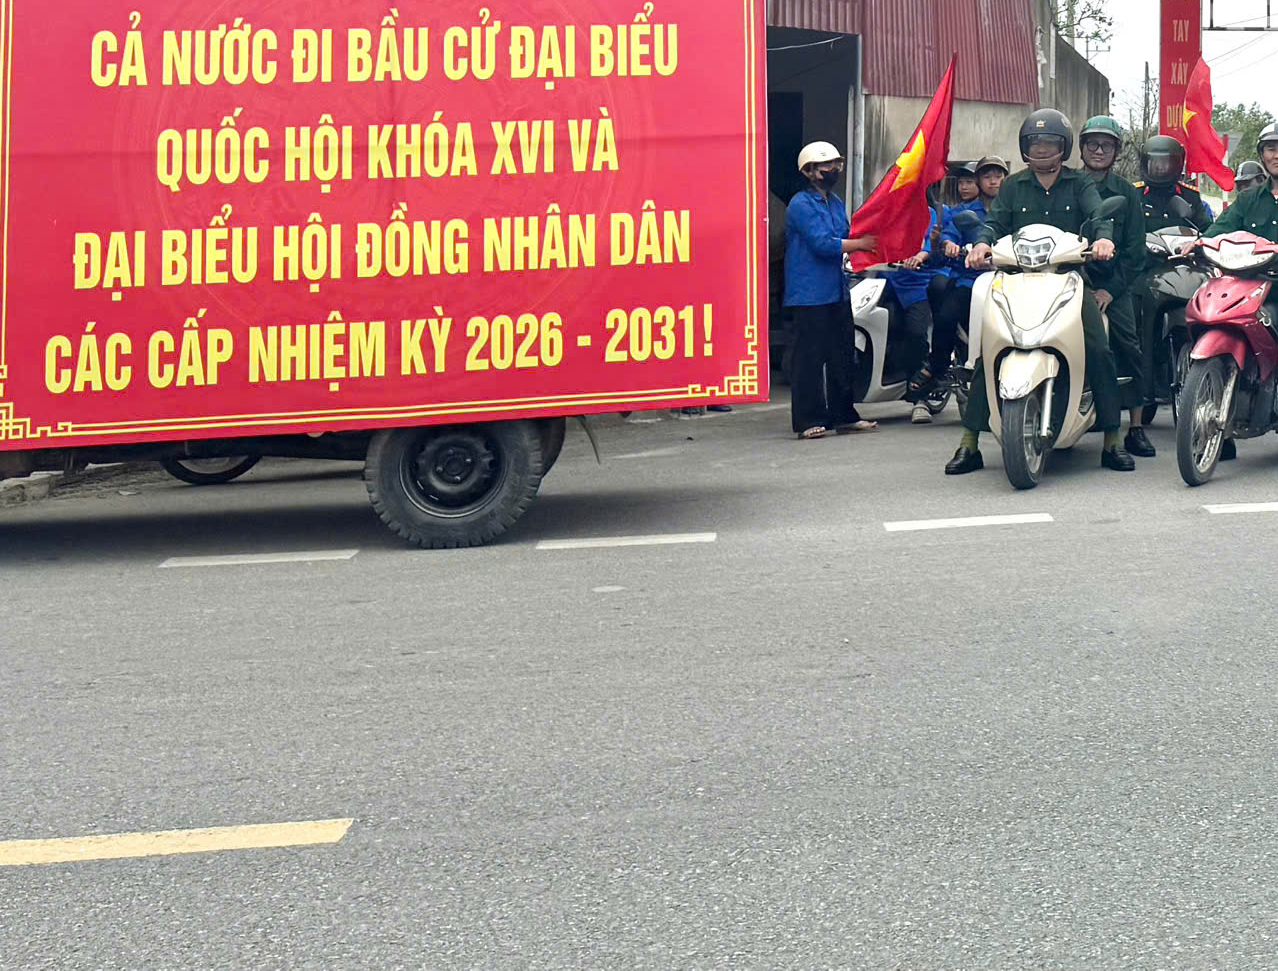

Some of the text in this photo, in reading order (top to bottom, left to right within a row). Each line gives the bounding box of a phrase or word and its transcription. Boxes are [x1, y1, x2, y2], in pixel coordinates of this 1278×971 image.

[91, 2, 677, 90] CẢ NƯỚC ĐI BẦU CỬ ĐẠI BIỂU
[1173, 20, 1190, 42] TAY
[157, 107, 618, 193] QUỐC HỘI KHÓA XVI VÀ
[1167, 103, 1184, 131] DỰN
[73, 200, 689, 301] ĐẠI BIỂU HỘI ĐỒNG NHÂN DÂN
[46, 304, 712, 393] CÁC CẤP NHIỆM KỲ 2026 - 2031!
